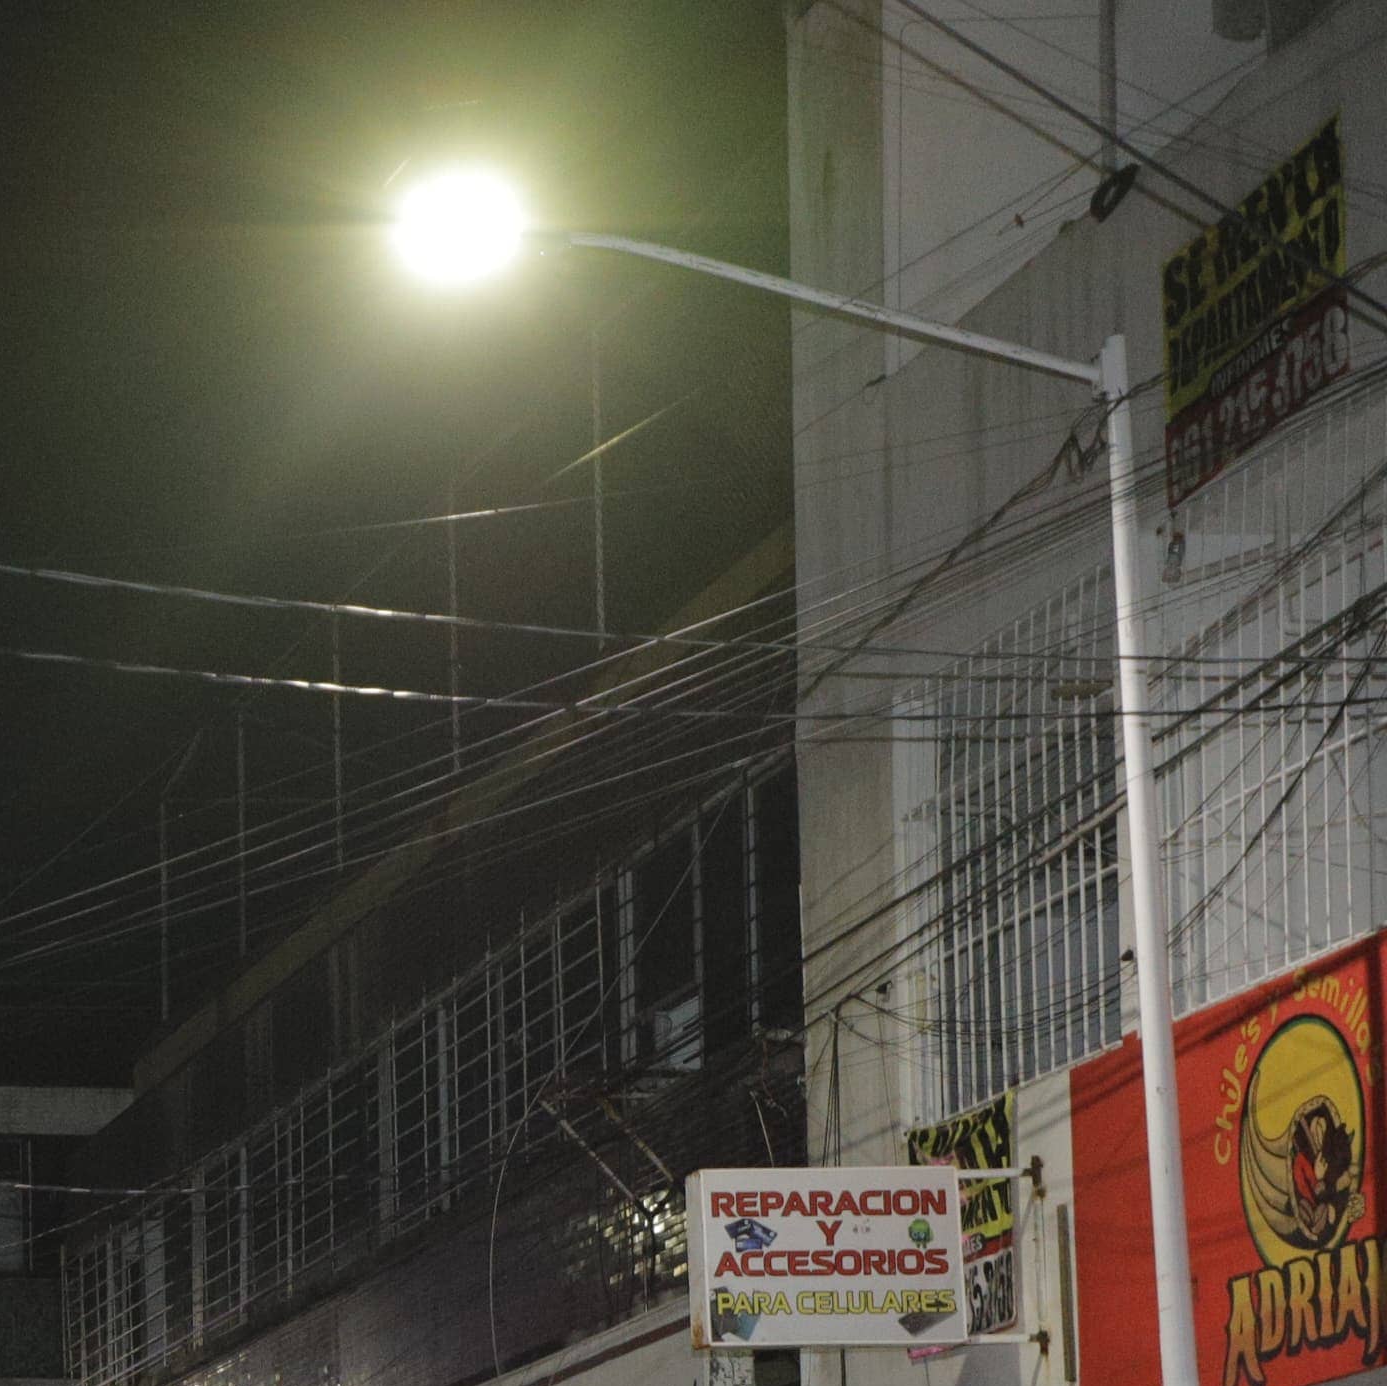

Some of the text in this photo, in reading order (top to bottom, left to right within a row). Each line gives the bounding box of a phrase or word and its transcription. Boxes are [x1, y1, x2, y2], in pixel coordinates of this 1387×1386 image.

[710, 1189, 947, 1217] REPARACION
[817, 1220, 843, 1246] Y
[714, 1248, 950, 1277] ACCESORIOS
[717, 1289, 957, 1316] PARA CELULARES
